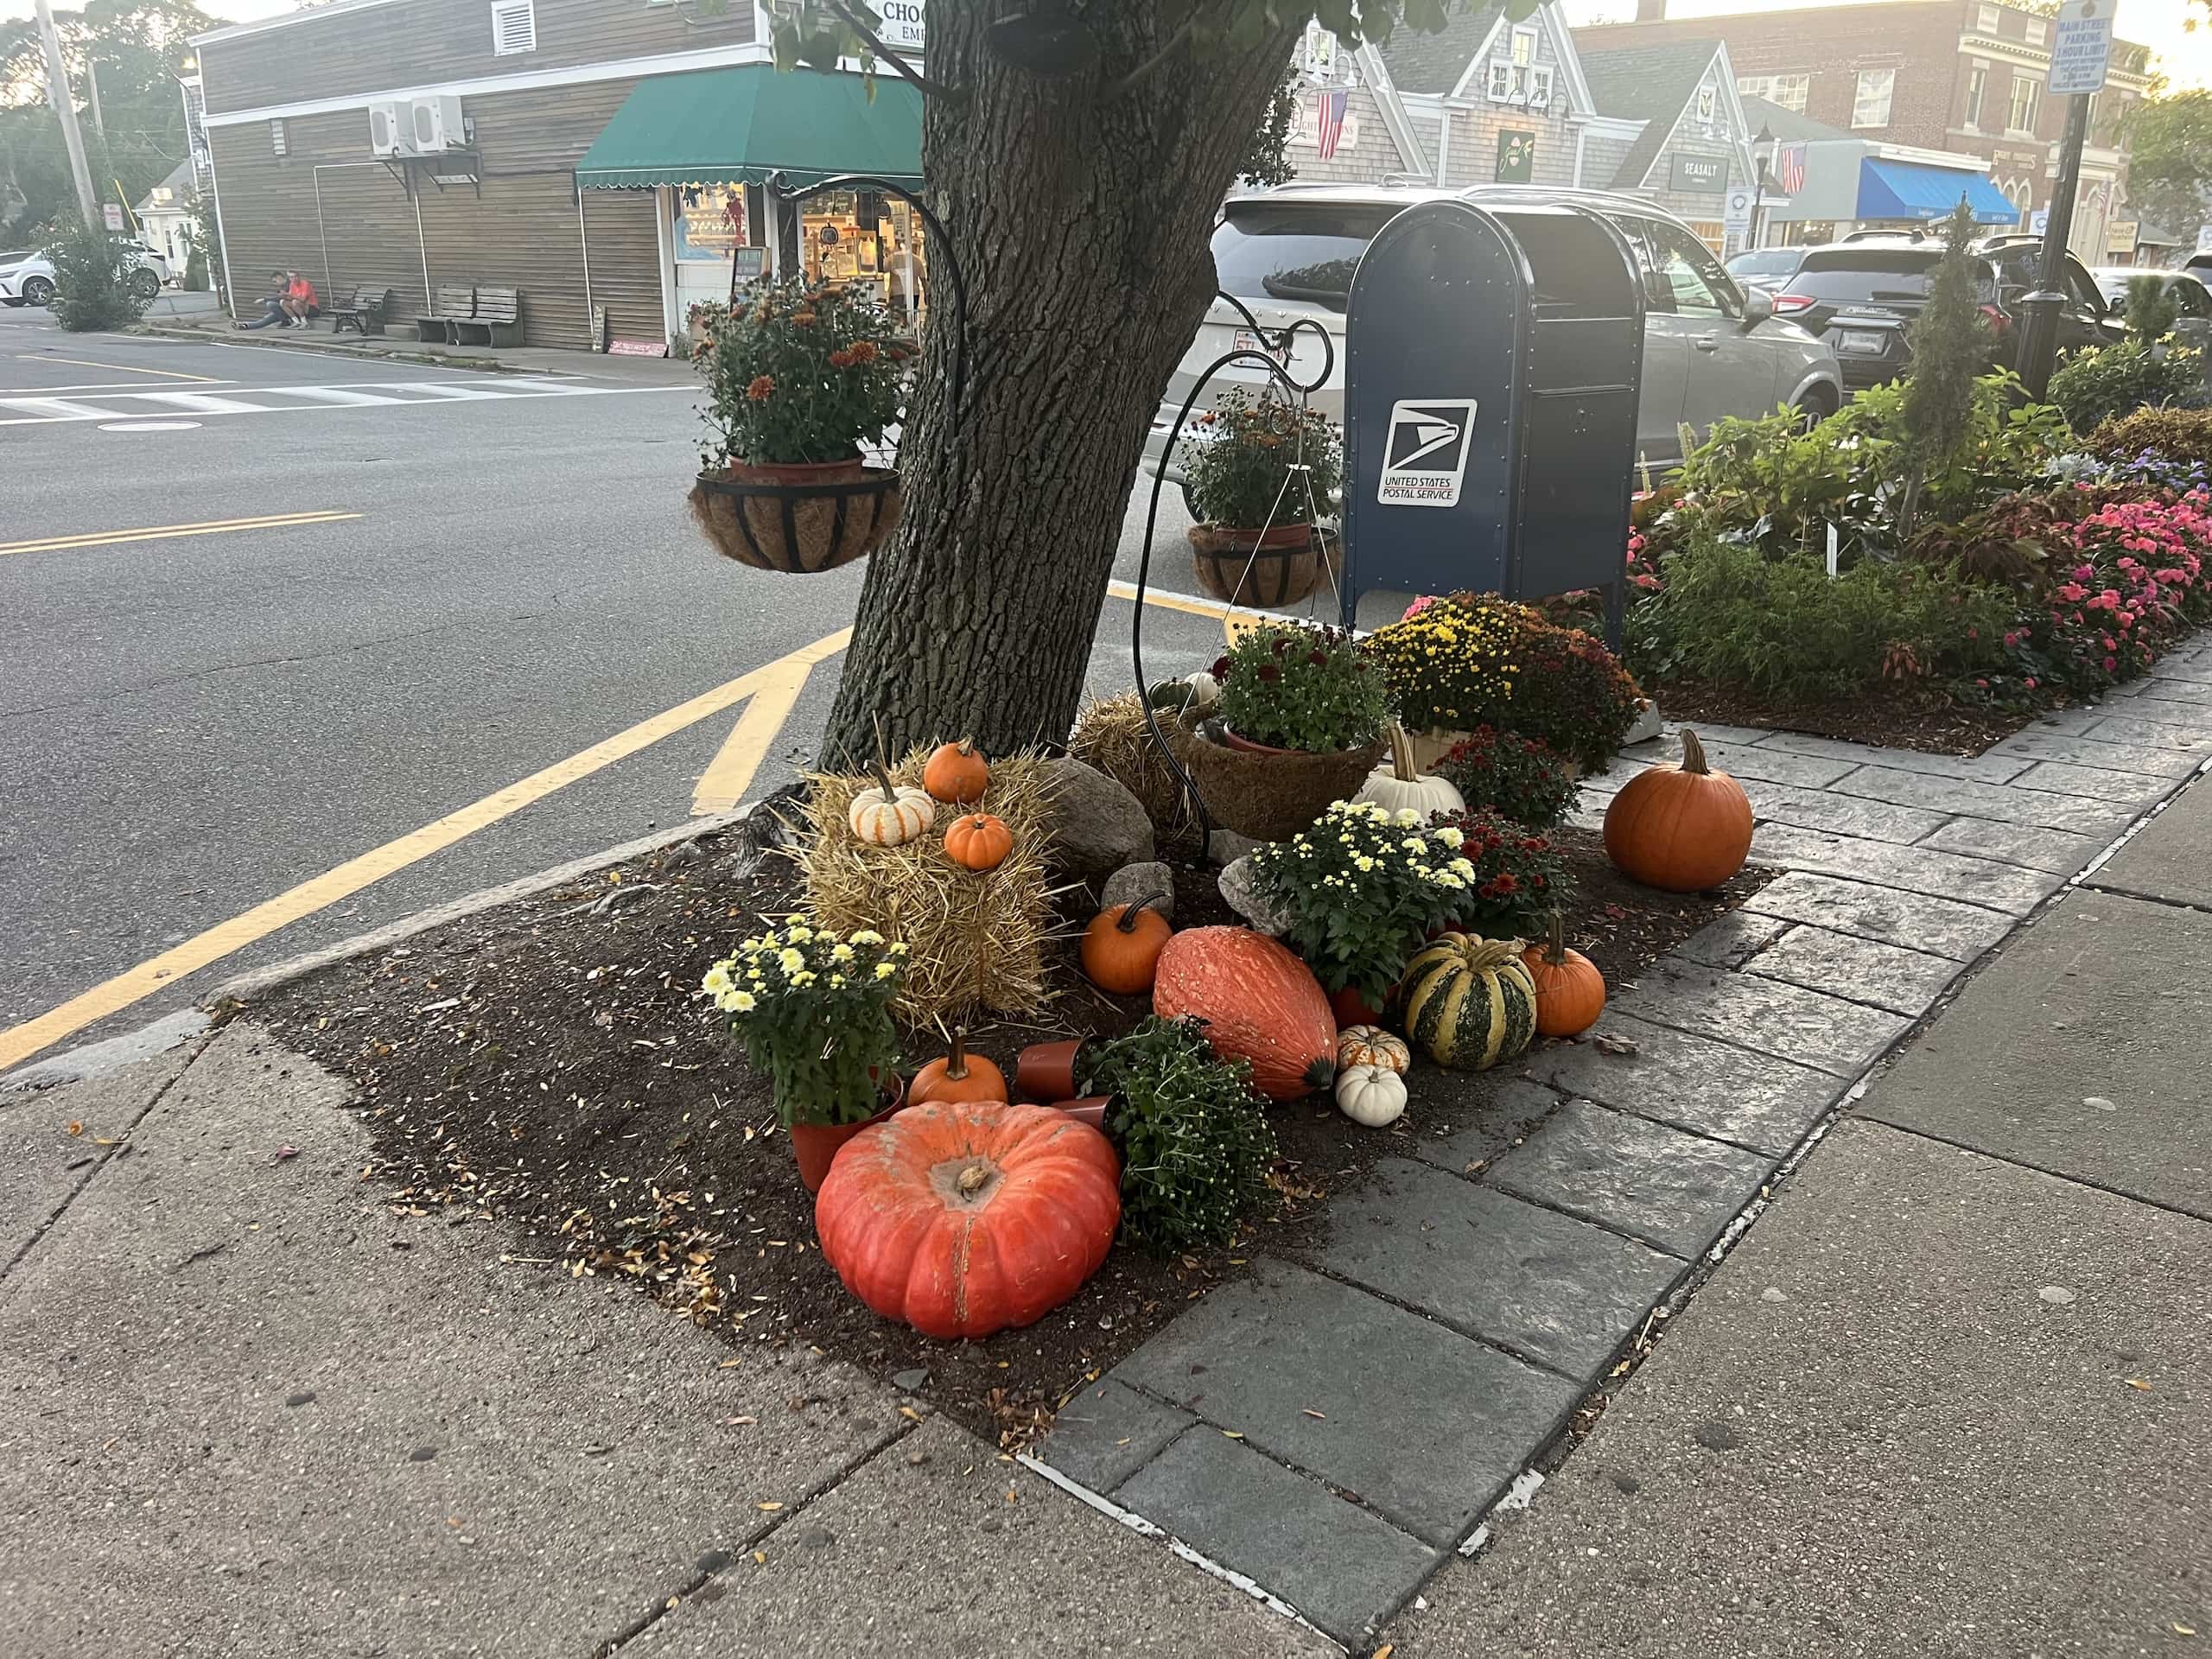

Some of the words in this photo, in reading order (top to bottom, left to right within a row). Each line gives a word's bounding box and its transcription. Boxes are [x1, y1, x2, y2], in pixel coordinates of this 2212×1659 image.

[2066, 31, 2101, 44] PARKING
[2062, 46, 2083, 57] HOUR
[1292, 111, 1318, 132] EGHT
[1684, 162, 1718, 177] SEASALT
[1385, 476, 1418, 486] UNITED
[1419, 477, 1452, 487] STATES
[1382, 488, 1415, 499] POSTAL
[1416, 490, 1452, 500] SERVICE
